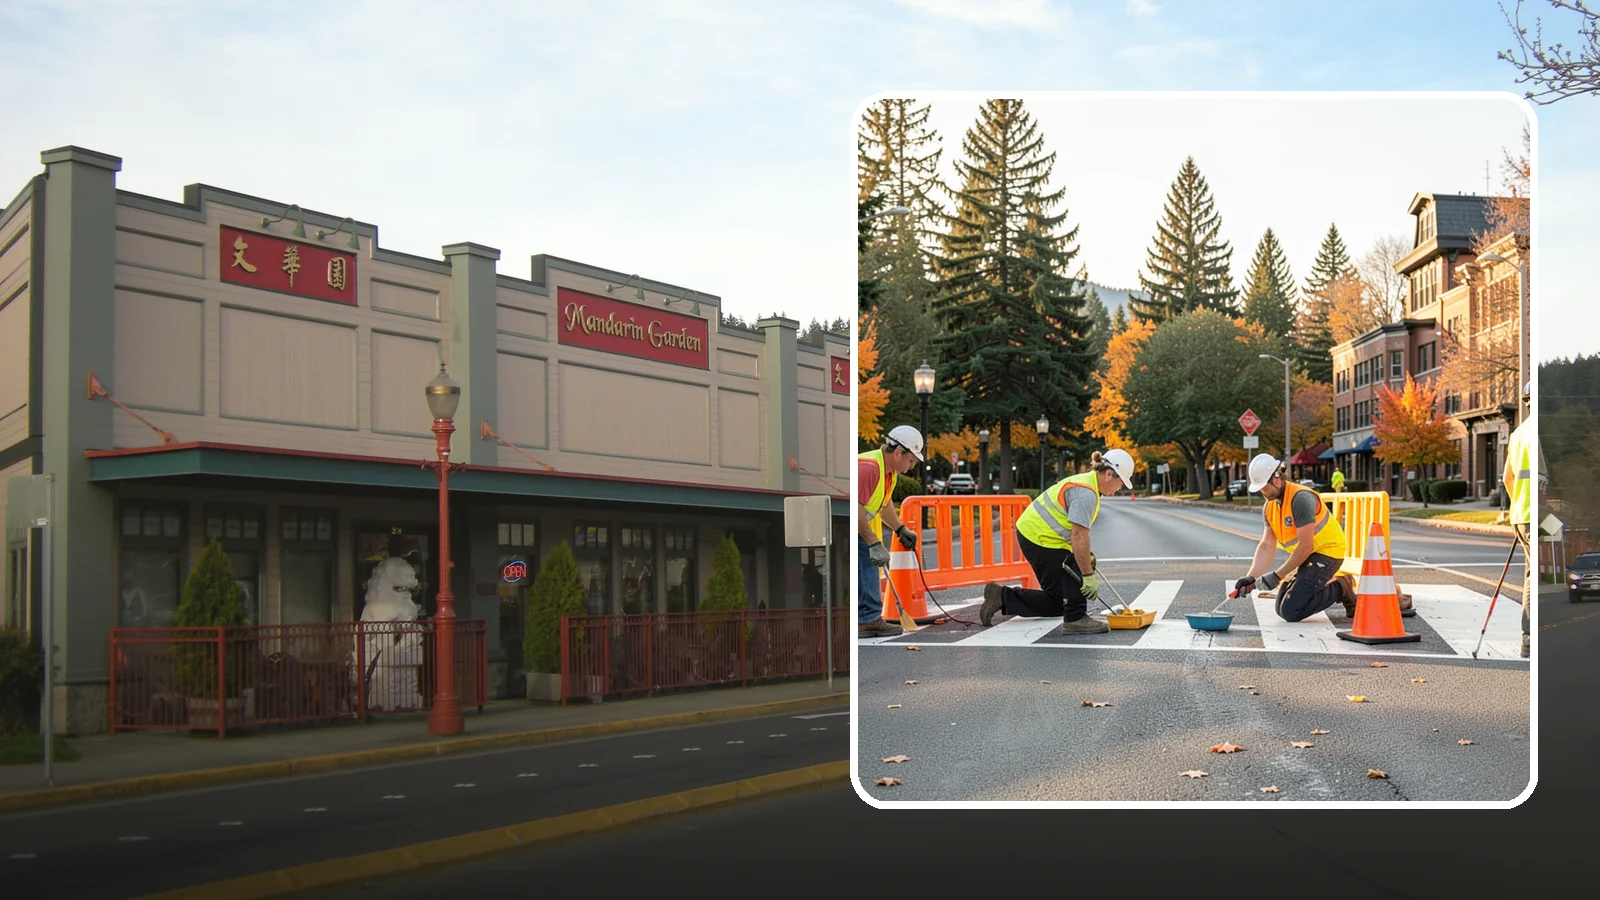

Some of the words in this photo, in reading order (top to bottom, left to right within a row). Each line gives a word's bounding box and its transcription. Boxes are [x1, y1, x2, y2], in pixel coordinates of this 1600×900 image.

[231, 236, 346, 290] 文華園
[564, 302, 644, 341] Mandarin
[648, 320, 701, 352] Garden
[834, 363, 847, 386] 文
[503, 565, 527, 578] OPEN
